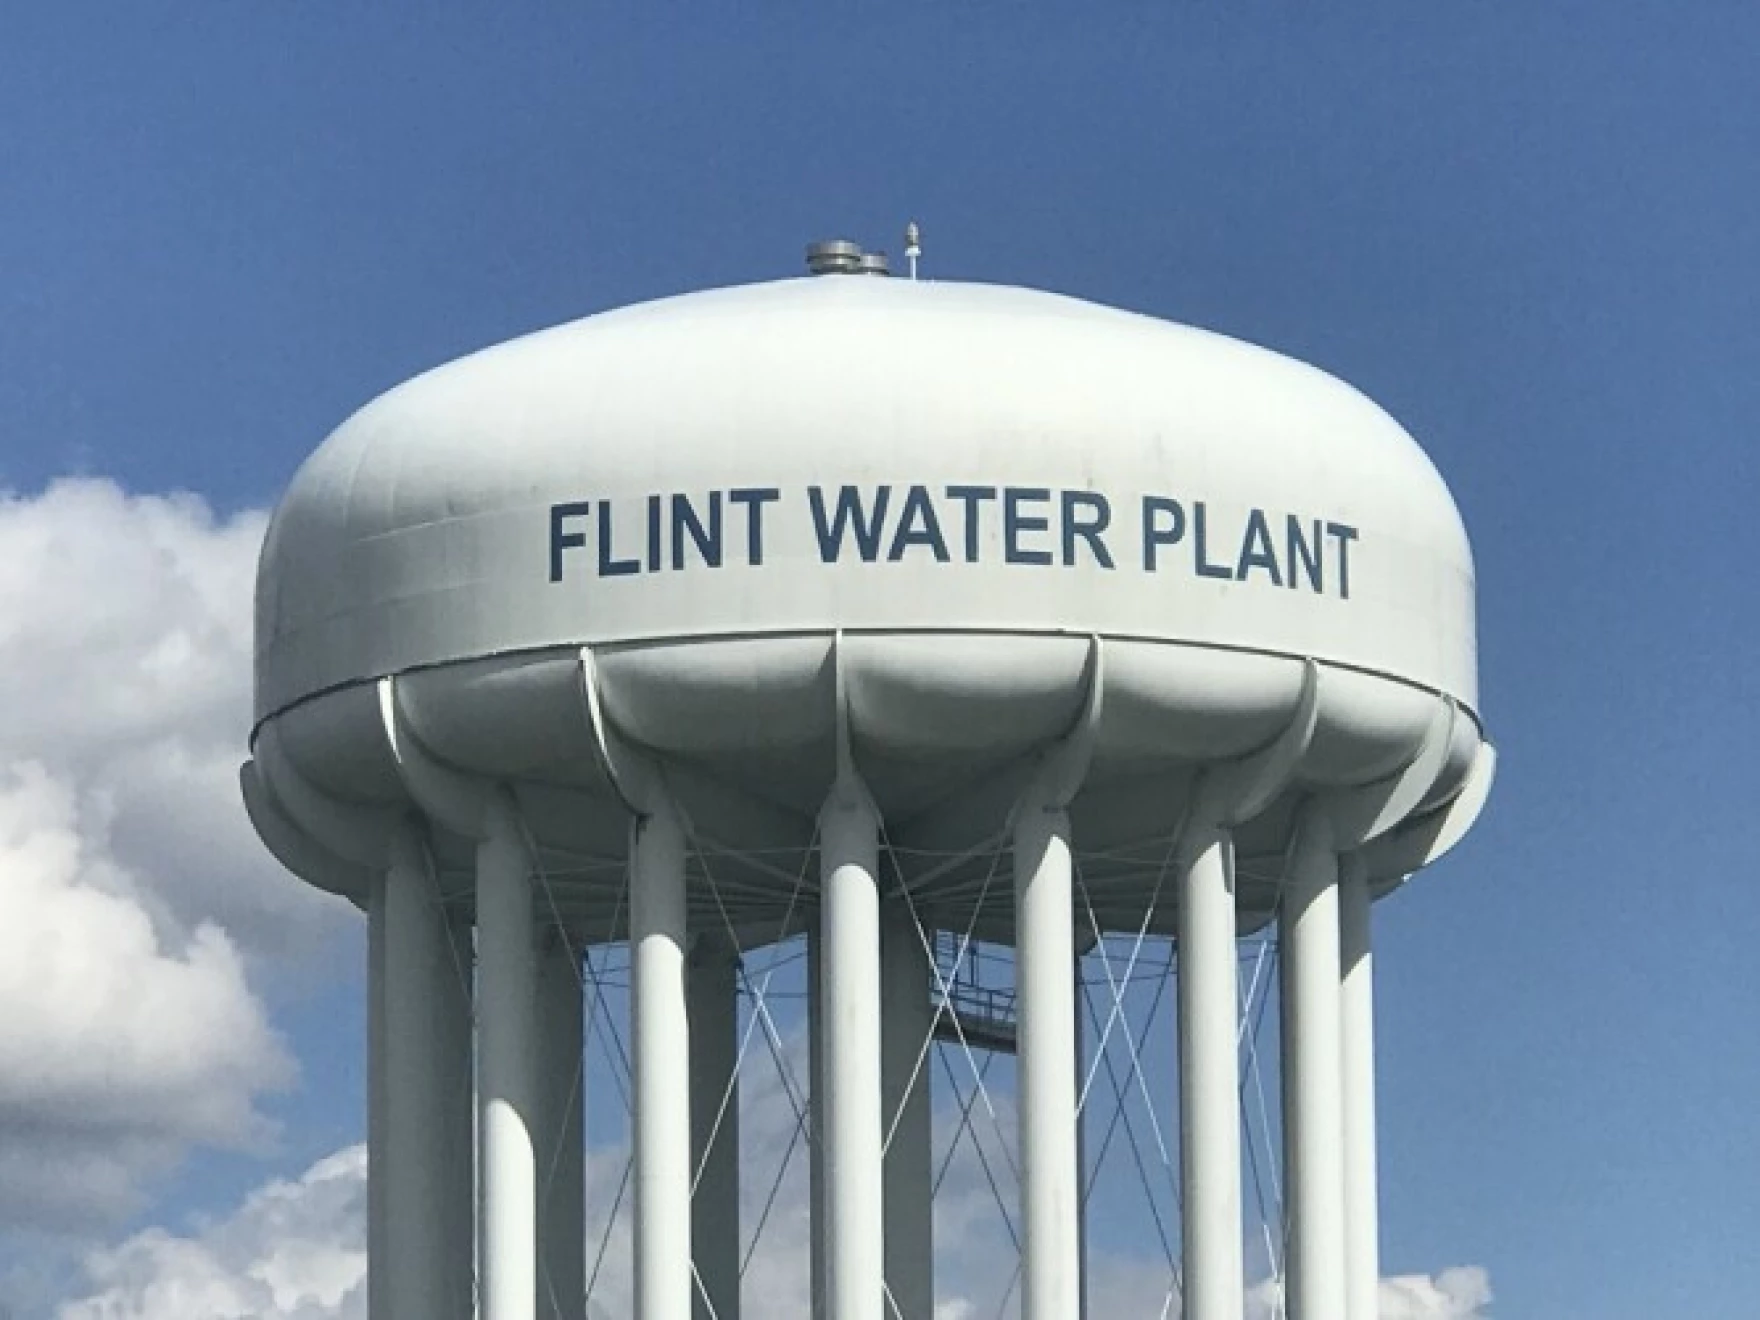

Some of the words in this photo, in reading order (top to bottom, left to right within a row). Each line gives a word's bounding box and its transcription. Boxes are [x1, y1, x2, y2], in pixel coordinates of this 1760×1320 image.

[549, 488, 779, 583] FLINT
[808, 485, 1115, 568] WATER
[1142, 495, 1358, 600] PLANT
